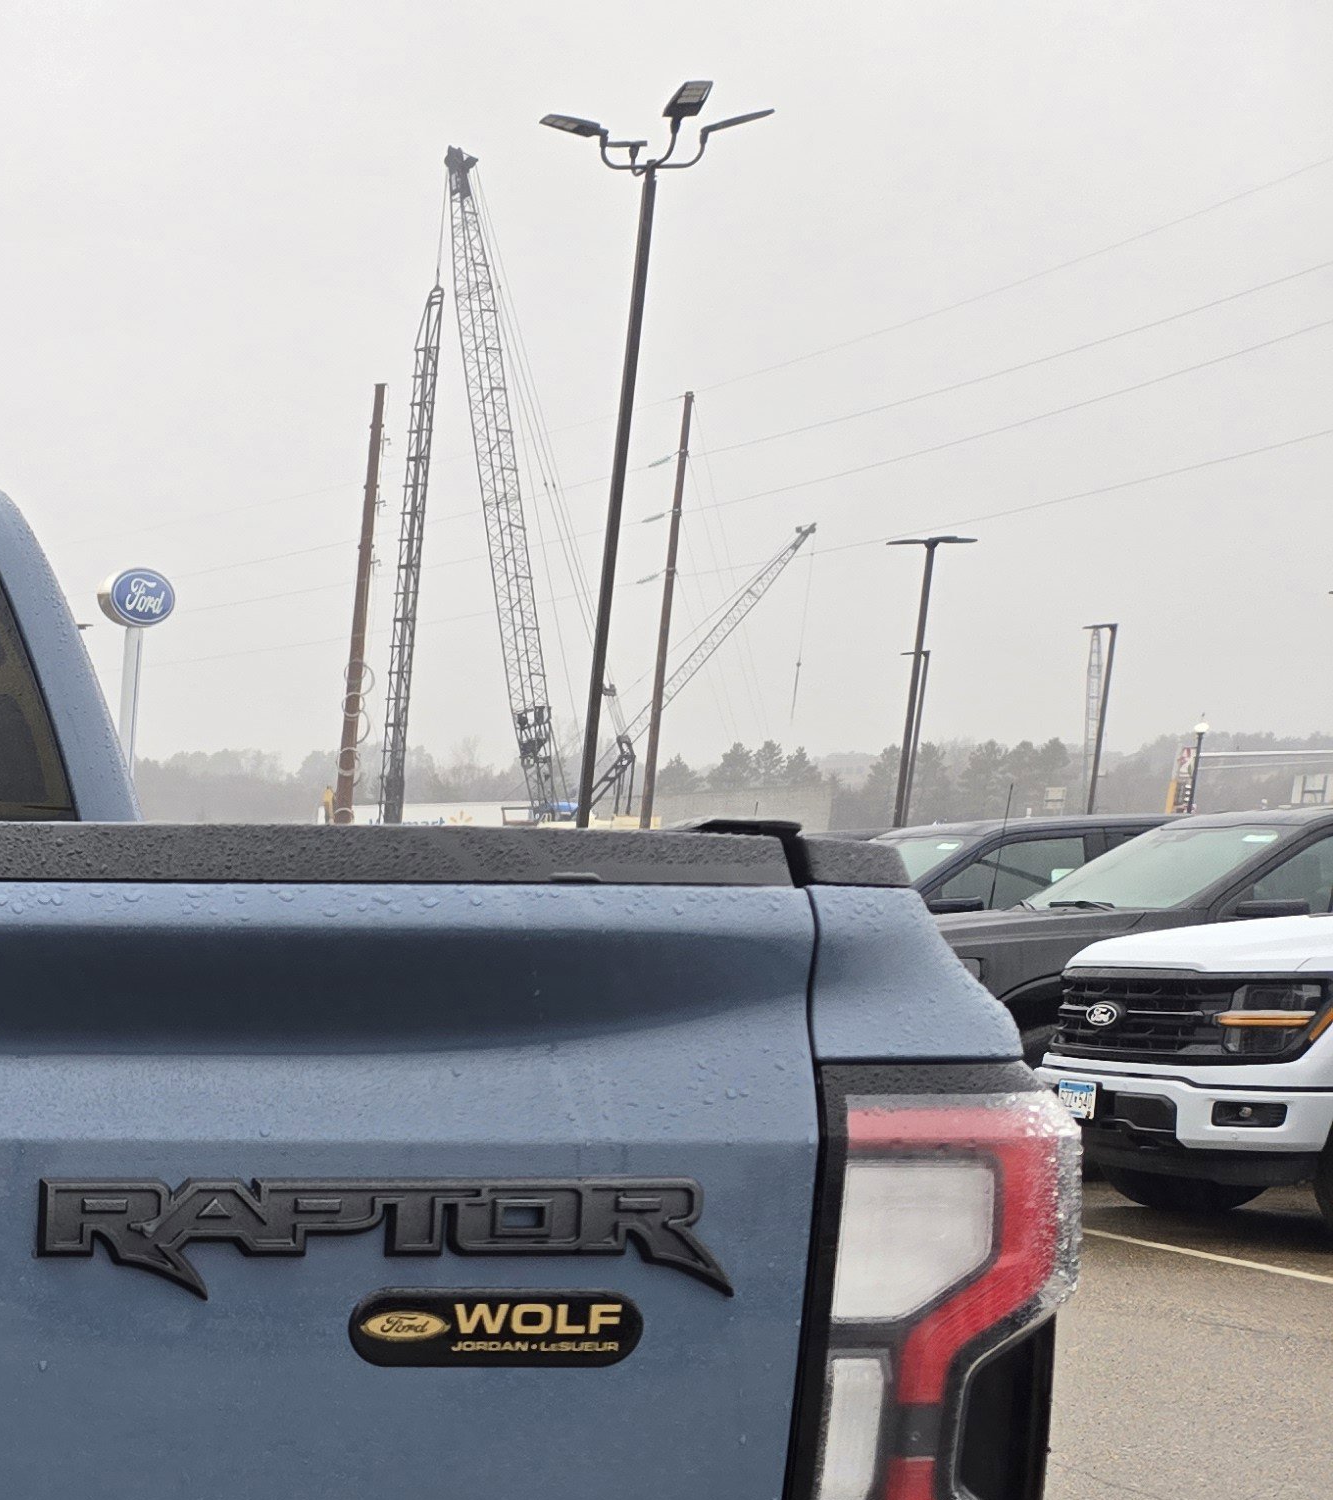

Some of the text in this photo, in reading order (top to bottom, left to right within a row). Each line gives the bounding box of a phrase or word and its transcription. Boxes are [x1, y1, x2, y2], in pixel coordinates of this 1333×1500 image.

[125, 577, 165, 615] Ford
[36, 1176, 735, 1300] RAPTOR
[379, 1315, 429, 1334] Ford
[453, 1302, 623, 1335] WOLF
[450, 1340, 529, 1352] JORDAN
